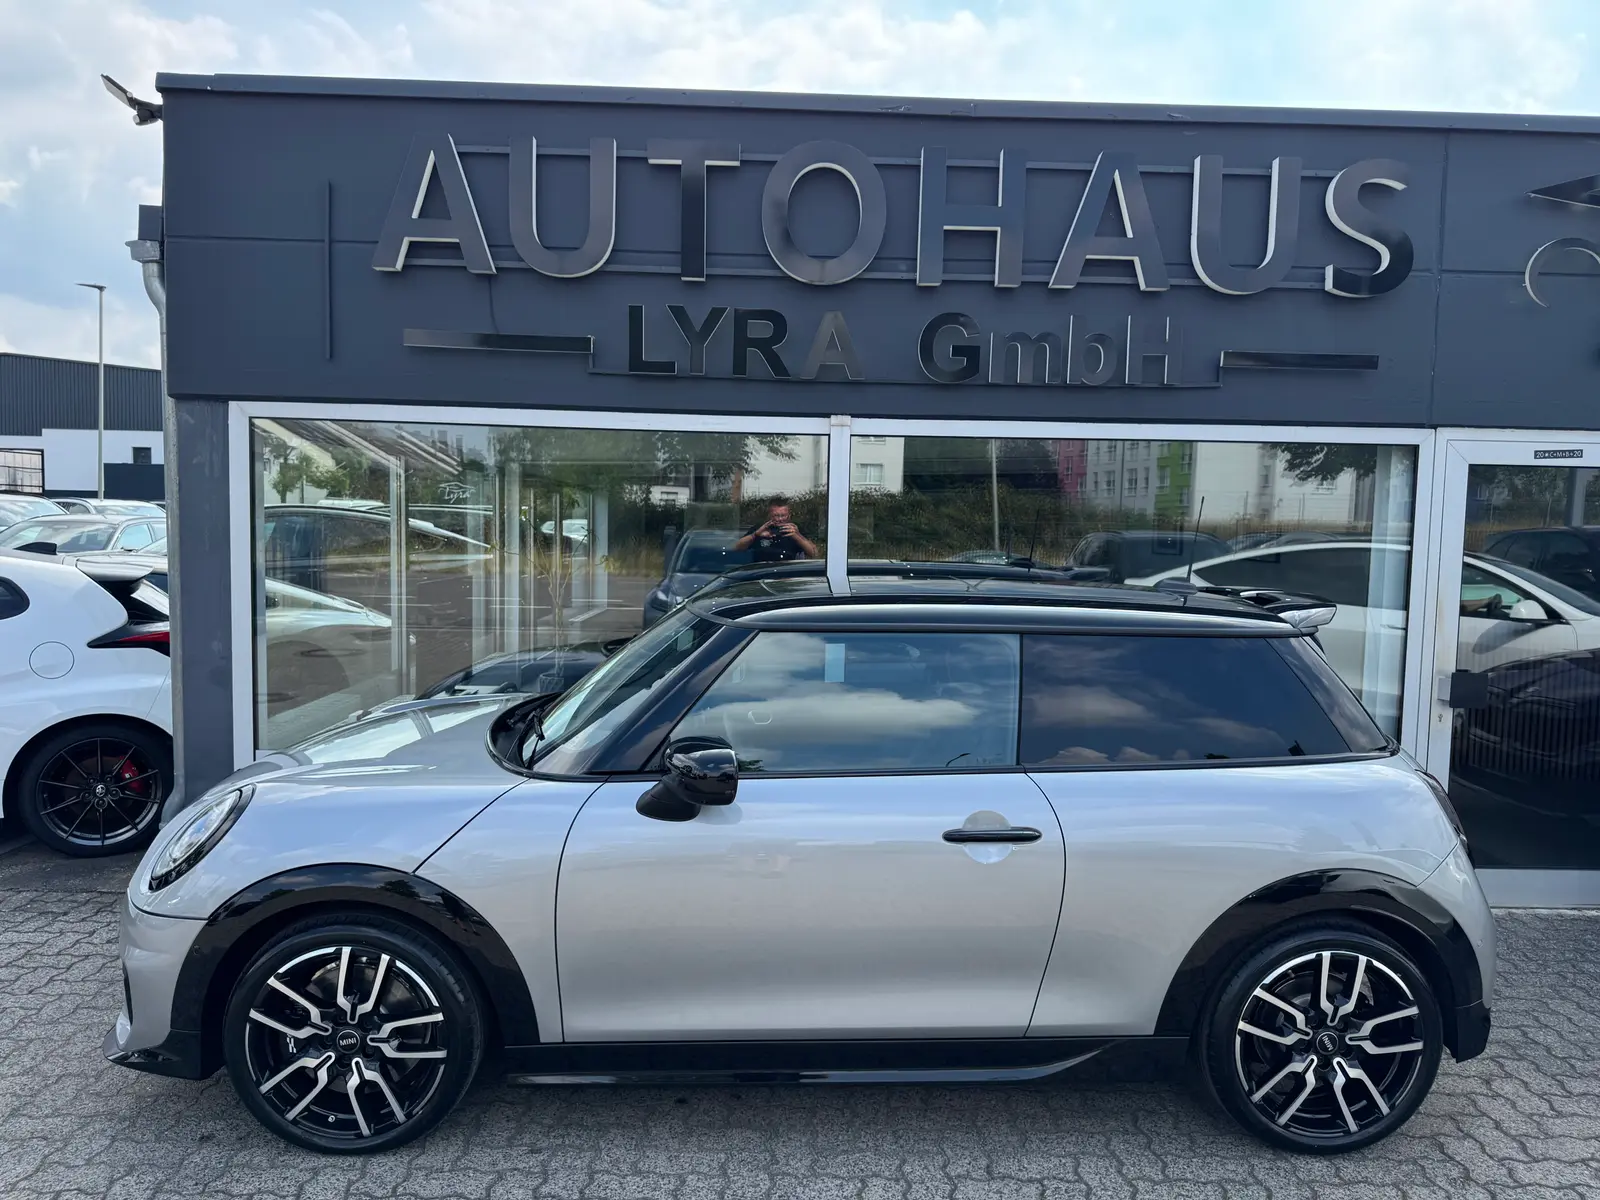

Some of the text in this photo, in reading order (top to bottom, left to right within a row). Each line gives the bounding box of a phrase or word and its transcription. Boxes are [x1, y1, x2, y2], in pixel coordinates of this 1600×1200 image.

[372, 132, 1415, 298] AUTOHAUS
[628, 303, 1184, 386] LYRA GmbH
[339, 1037, 357, 1046] MINI
[1322, 1035, 1334, 1051] MINI
